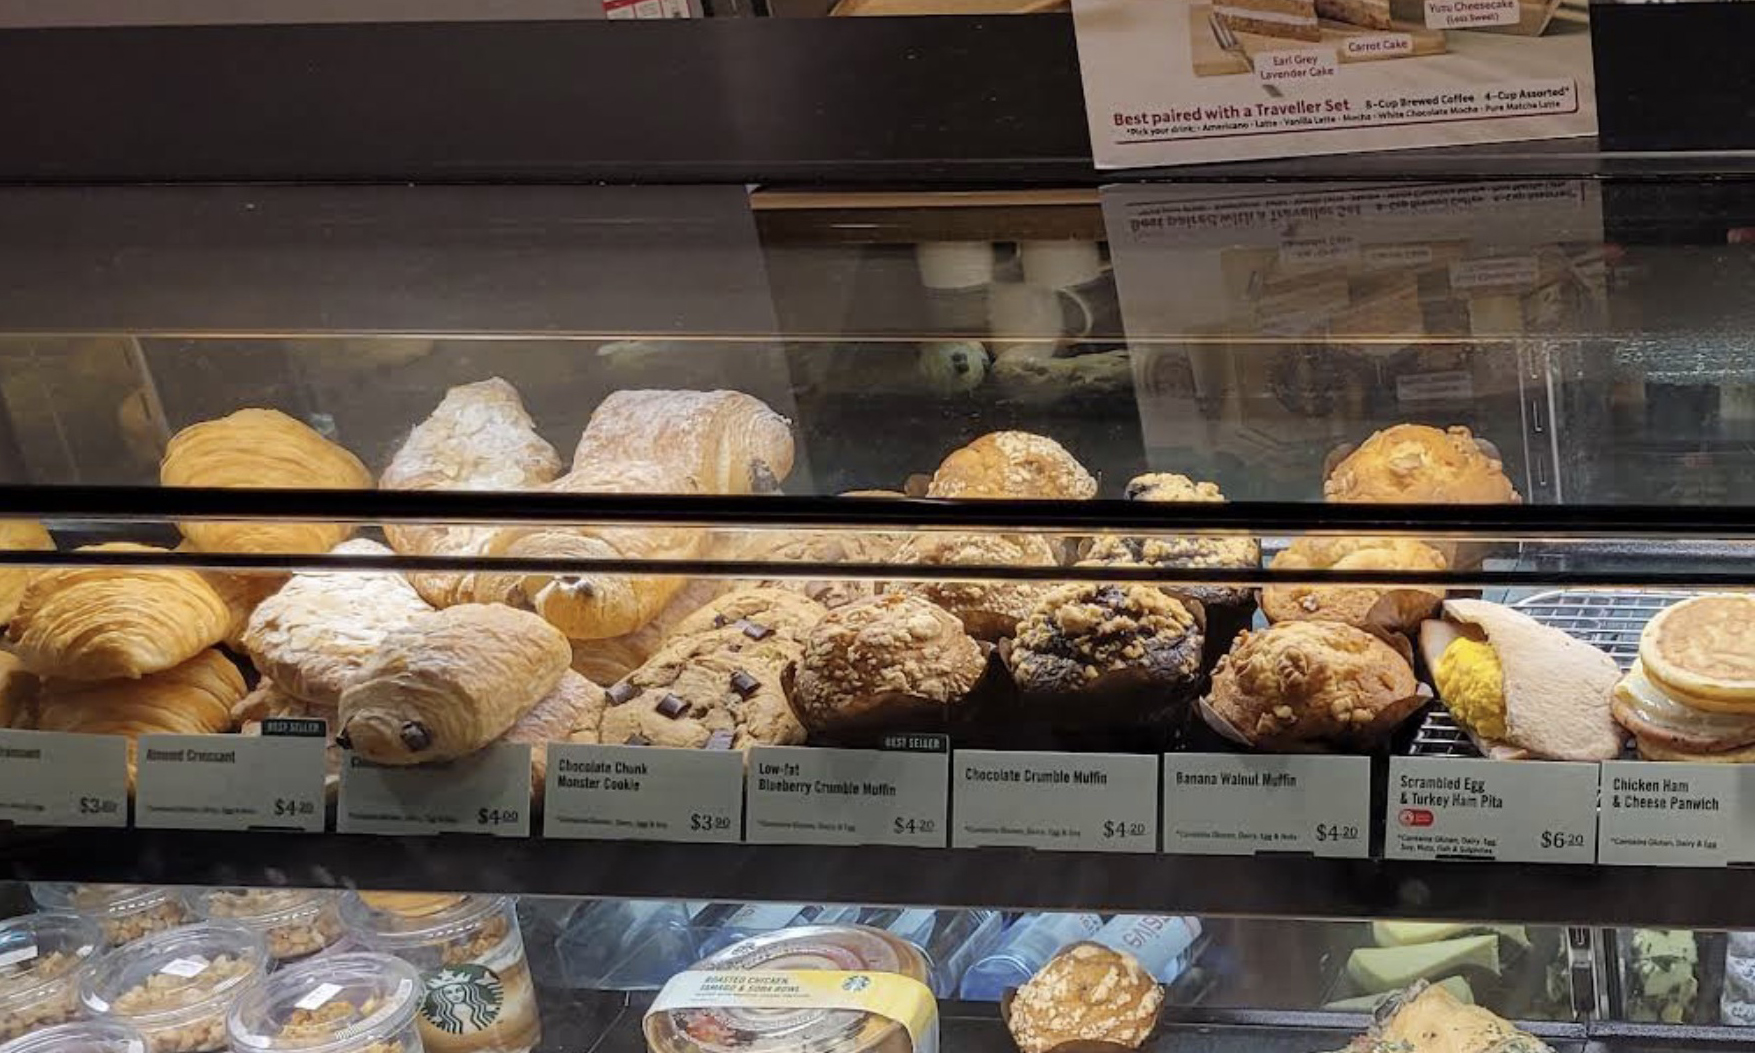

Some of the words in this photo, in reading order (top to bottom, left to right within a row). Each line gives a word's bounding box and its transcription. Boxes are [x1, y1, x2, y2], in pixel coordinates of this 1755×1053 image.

[1349, 41, 1379, 53] Carrot
[1382, 38, 1407, 51] Cake
[1273, 55, 1293, 66] Earl
[1296, 54, 1318, 68] Grey
[1261, 68, 1306, 80] Lavender
[1308, 66, 1334, 77] Cake
[1114, 112, 1149, 126] Best
[1153, 108, 1200, 126] paired
[1203, 106, 1238, 120] with
[1243, 108, 1252, 118] a
[1256, 101, 1321, 116] Traveller
[1326, 100, 1349, 113] Set
[558, 760, 611, 775] Chocolate
[615, 760, 648, 775] Chunk
[558, 775, 601, 791] Monster
[604, 777, 640, 792] Cookie
[965, 768, 1021, 783] Chocolate
[1025, 769, 1070, 784] Crumble
[1073, 770, 1107, 785] Muffin
[1400, 776, 1461, 790] Scrambled
[1464, 778, 1485, 793] Egg
[1613, 777, 1660, 792] Chicken
[1663, 779, 1689, 792] Ham
[1400, 793, 1408, 805] &
[1412, 793, 1449, 808] Turkey
[1480, 795, 1503, 808] Pita
[1613, 796, 1621, 808] &
[1624, 796, 1666, 810] Cheese
[1670, 797, 1719, 811] Panwich
[1103, 820, 1145, 838] $4.20
[1540, 831, 1584, 849] $6.20
